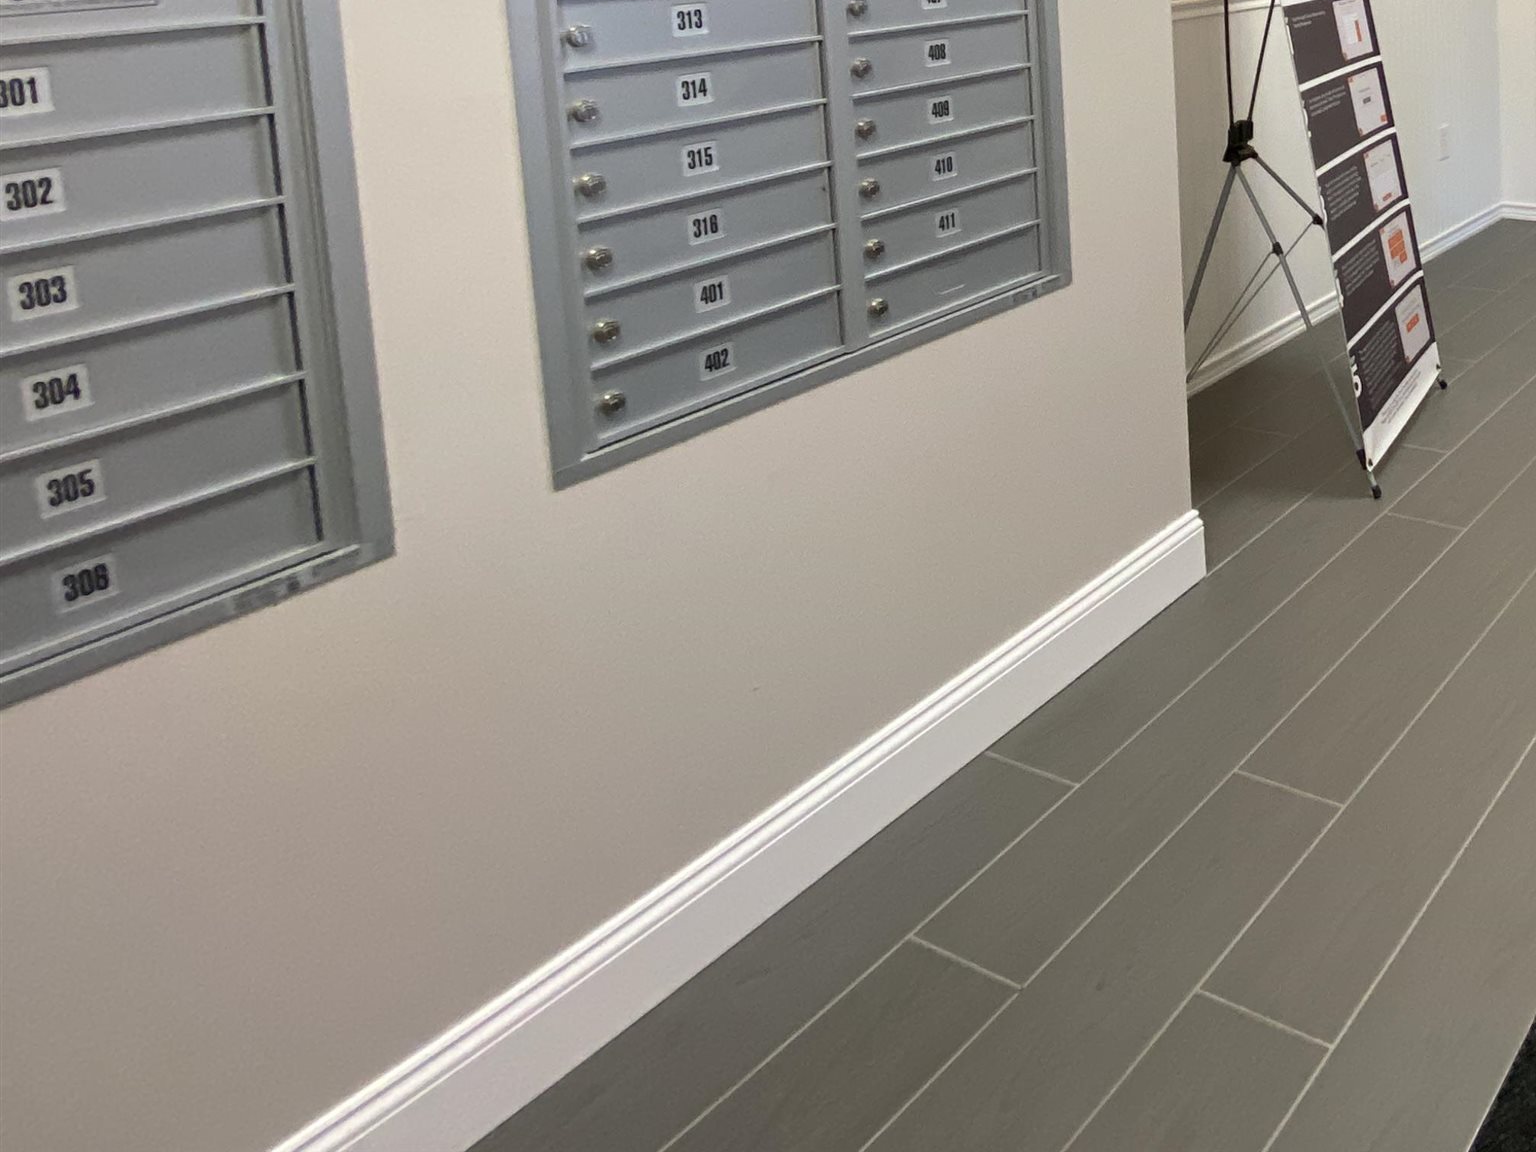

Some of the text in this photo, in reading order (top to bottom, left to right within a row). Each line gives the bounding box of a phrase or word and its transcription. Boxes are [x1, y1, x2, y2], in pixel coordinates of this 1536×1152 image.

[676, 9, 703, 31] 313
[681, 78, 708, 101] 314
[687, 146, 713, 170] 315
[934, 156, 953, 175] 410
[5, 177, 54, 211] 302
[938, 212, 956, 231] 411
[18, 275, 67, 310] 303
[700, 281, 723, 305] 401
[704, 348, 730, 372] 402
[32, 373, 81, 409] 304
[47, 469, 95, 507] 305
